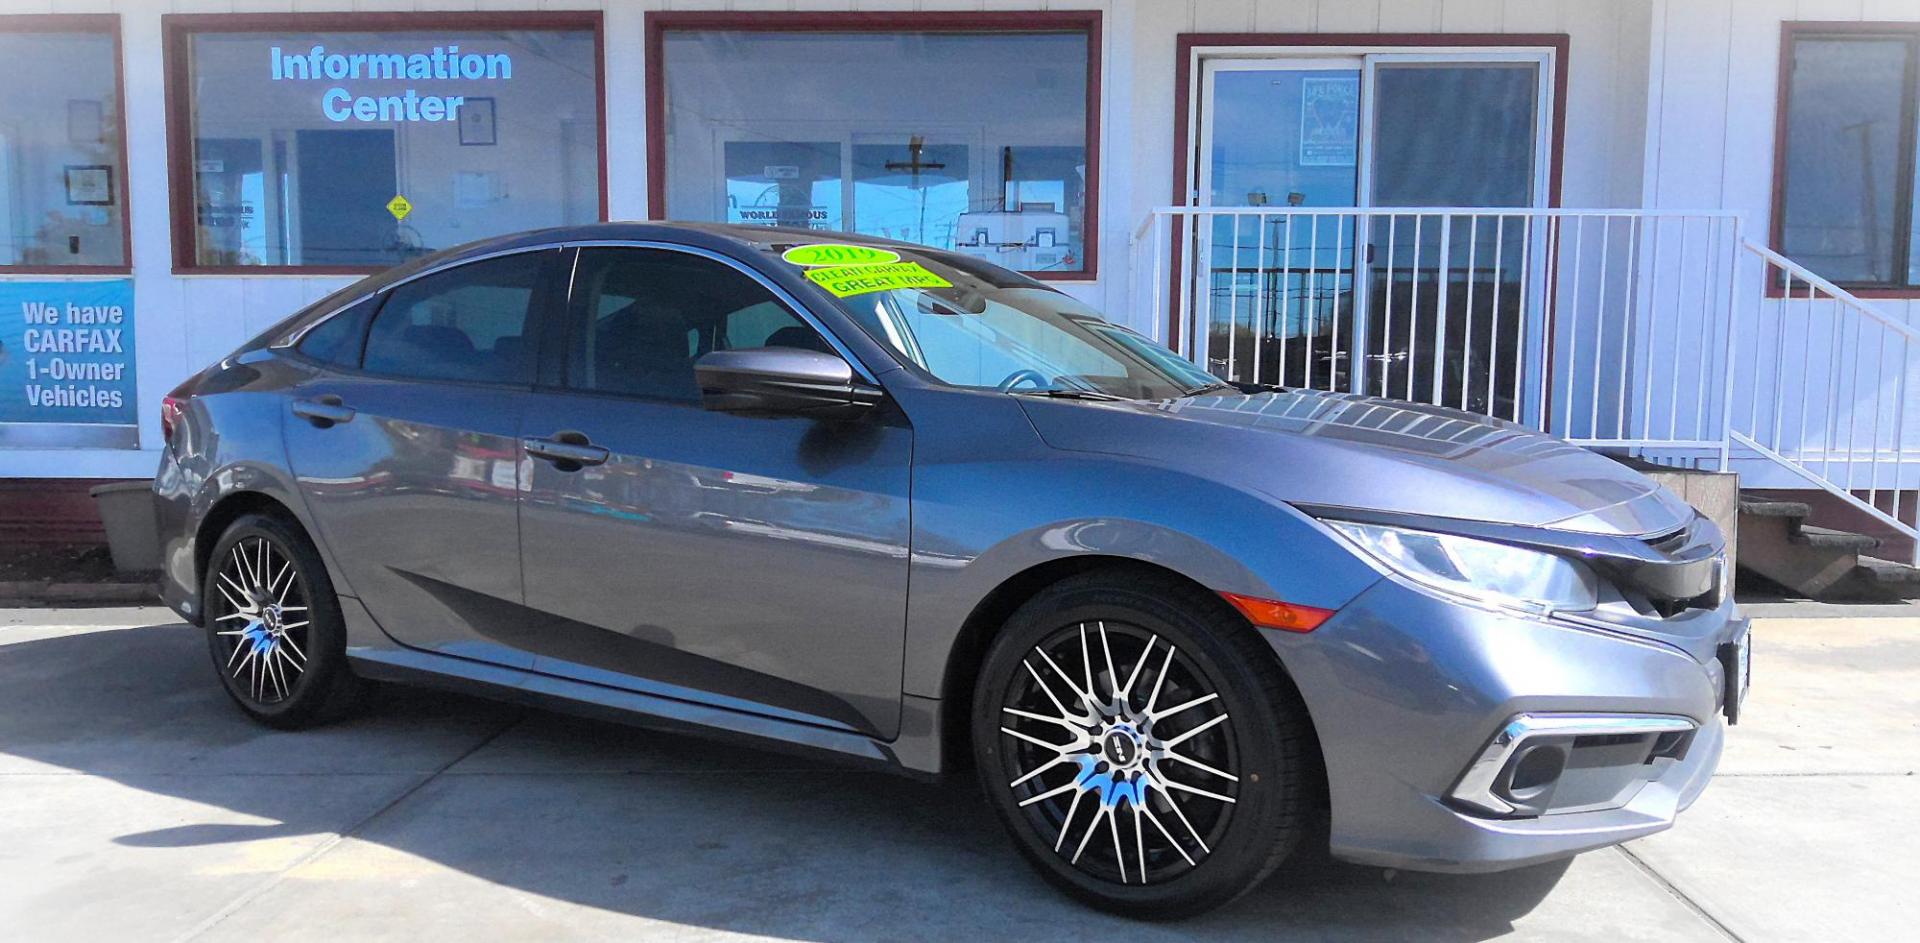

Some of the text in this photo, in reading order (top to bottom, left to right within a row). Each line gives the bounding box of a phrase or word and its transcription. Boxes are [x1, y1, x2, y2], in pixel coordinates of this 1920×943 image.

[271, 45, 512, 80] Information
[322, 87, 464, 122] Center
[832, 276, 896, 293] GREAT
[22, 301, 123, 325] We have
[23, 328, 123, 353] CARFAX
[26, 357, 125, 380] 1-Owner
[25, 384, 123, 408] Vehicles
